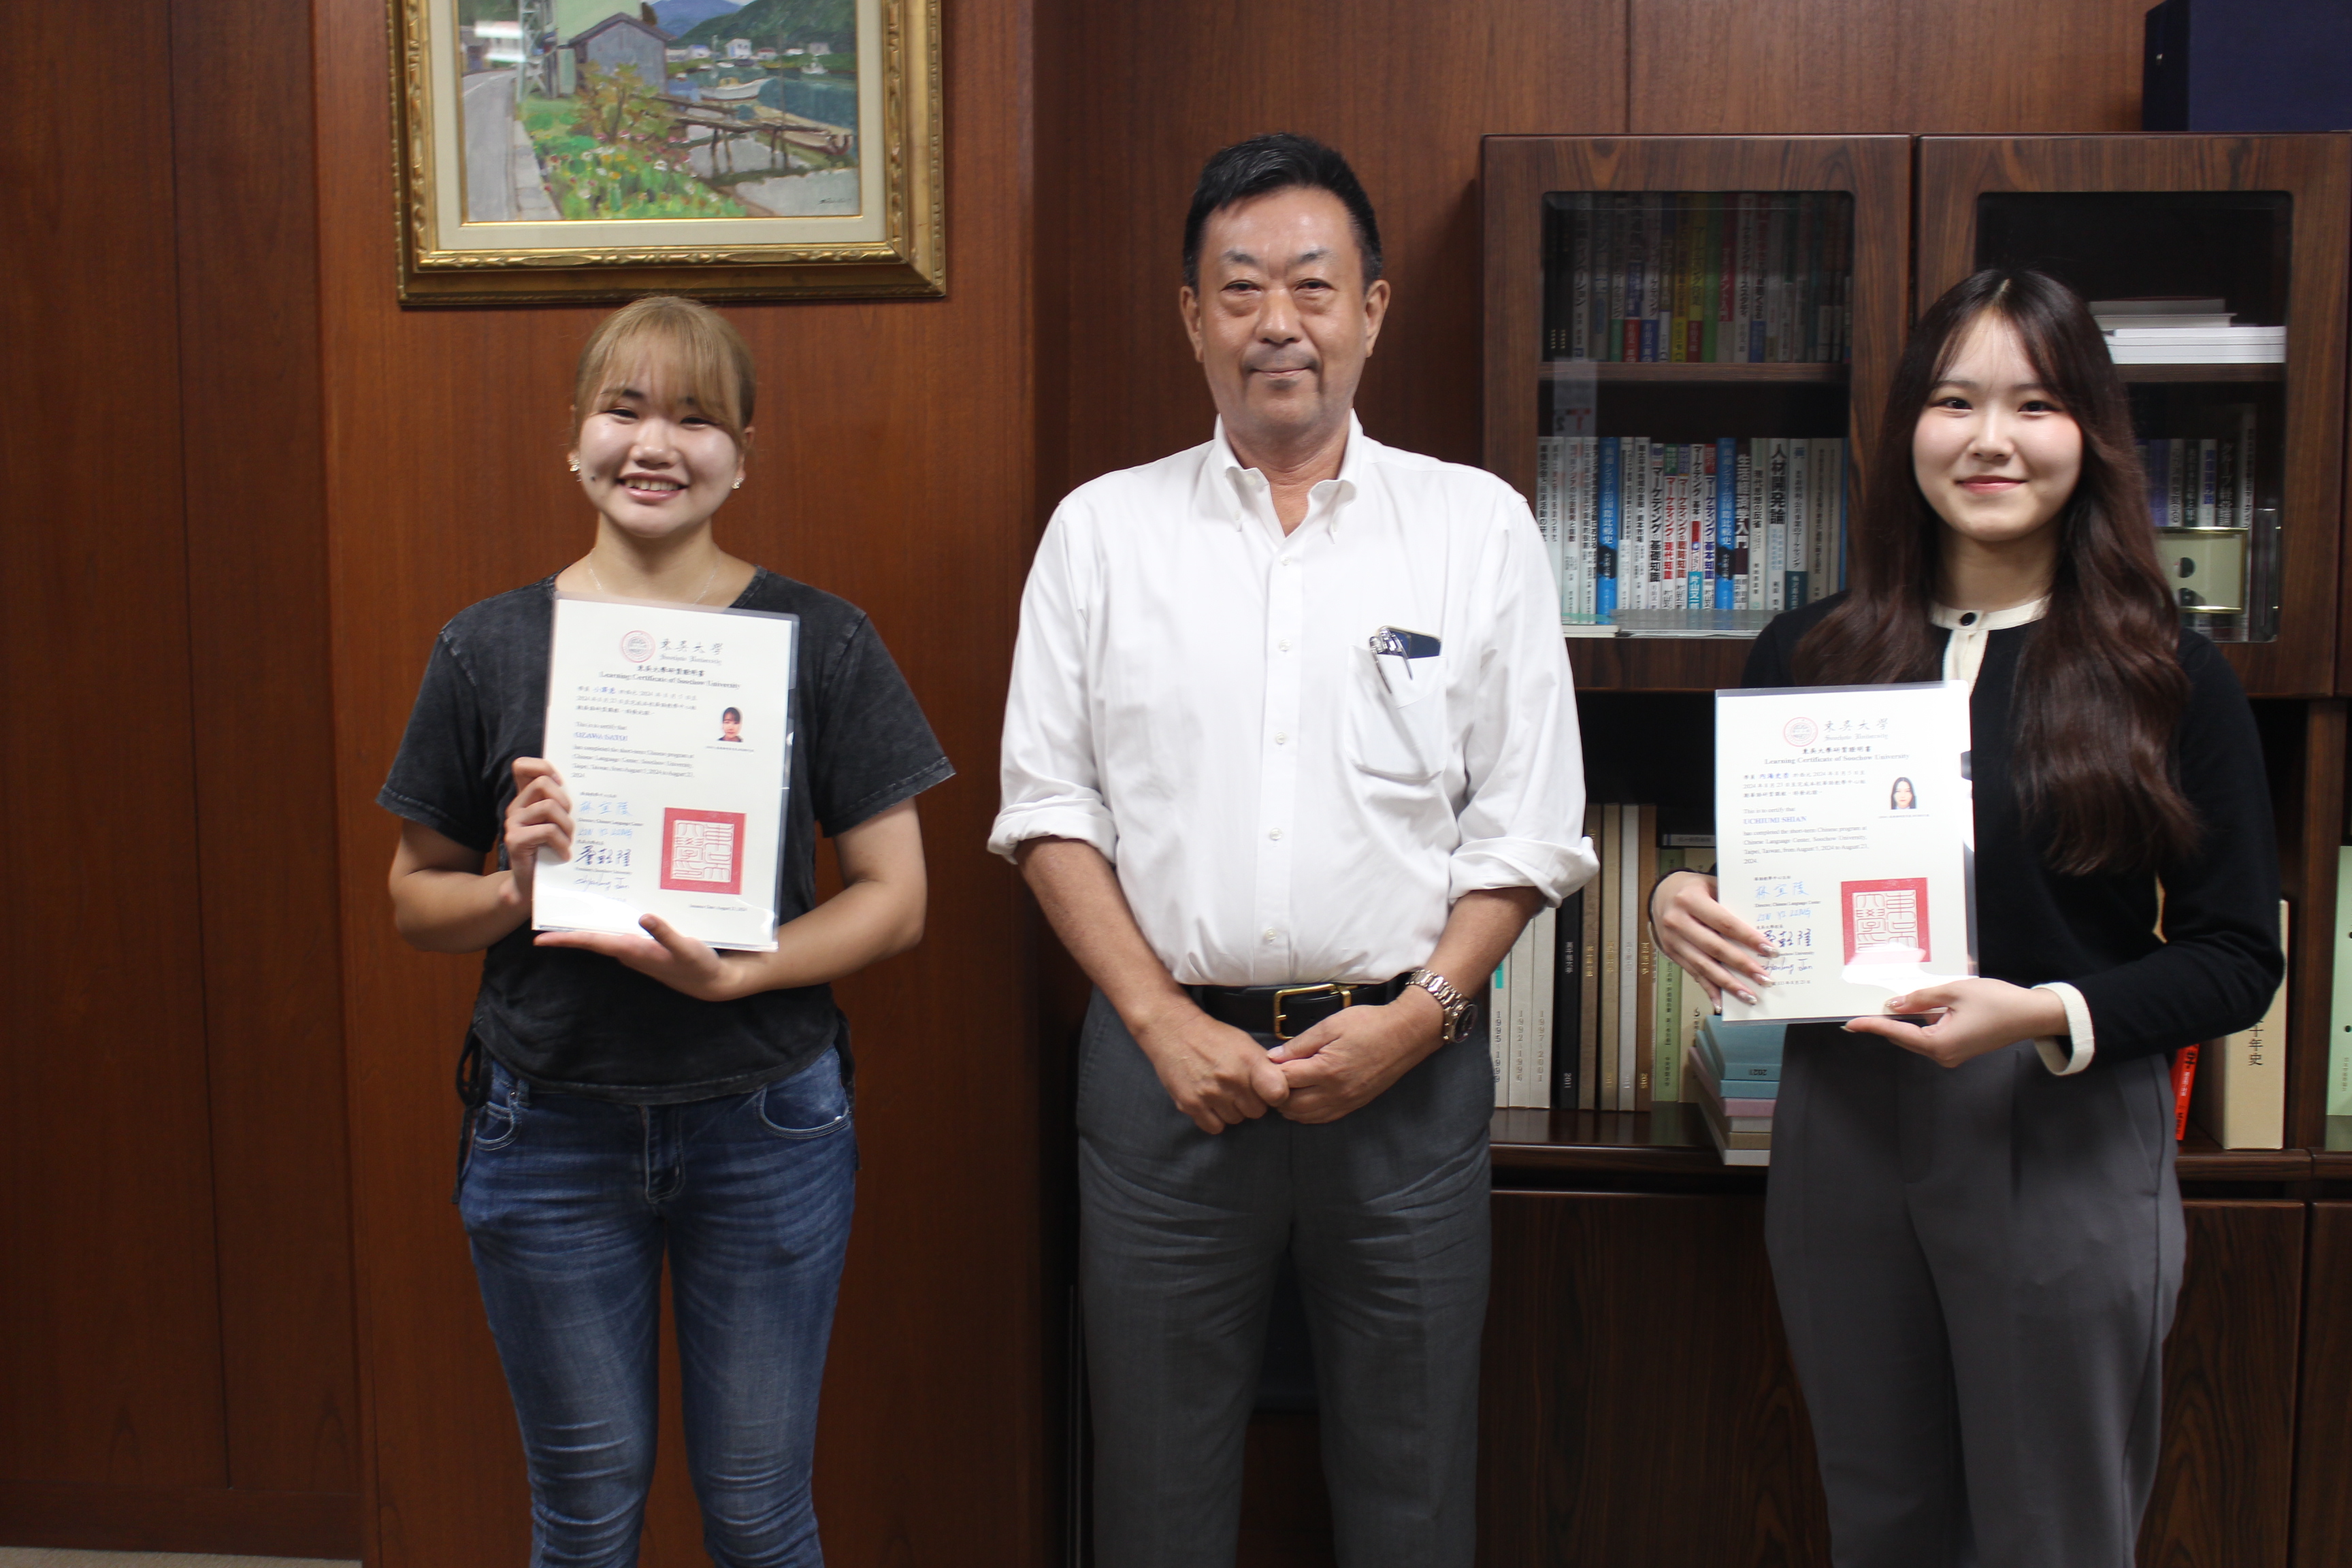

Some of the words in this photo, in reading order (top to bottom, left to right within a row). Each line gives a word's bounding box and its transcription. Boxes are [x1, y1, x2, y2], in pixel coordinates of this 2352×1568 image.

[1752, 470, 1764, 528] 現代思想の反省
[1769, 443, 1787, 525] 人材開発論
[1650, 468, 1663, 583] マーケティングの基礎知識
[1663, 477, 1676, 580] マーケティングの現代知識
[1704, 477, 1716, 580] マーケティングの基本知識
[599, 672, 632, 681] Learning
[633, 674, 666, 683] Certificate
[706, 680, 741, 689] University
[1764, 757, 1797, 766] Learning
[1797, 755, 1833, 764] Certificate
[1875, 753, 1910, 762] University
[1855, 732, 1889, 741] University
[2248, 1019, 2265, 1066] 十年史
[1563, 1073, 1572, 1088] 2011
